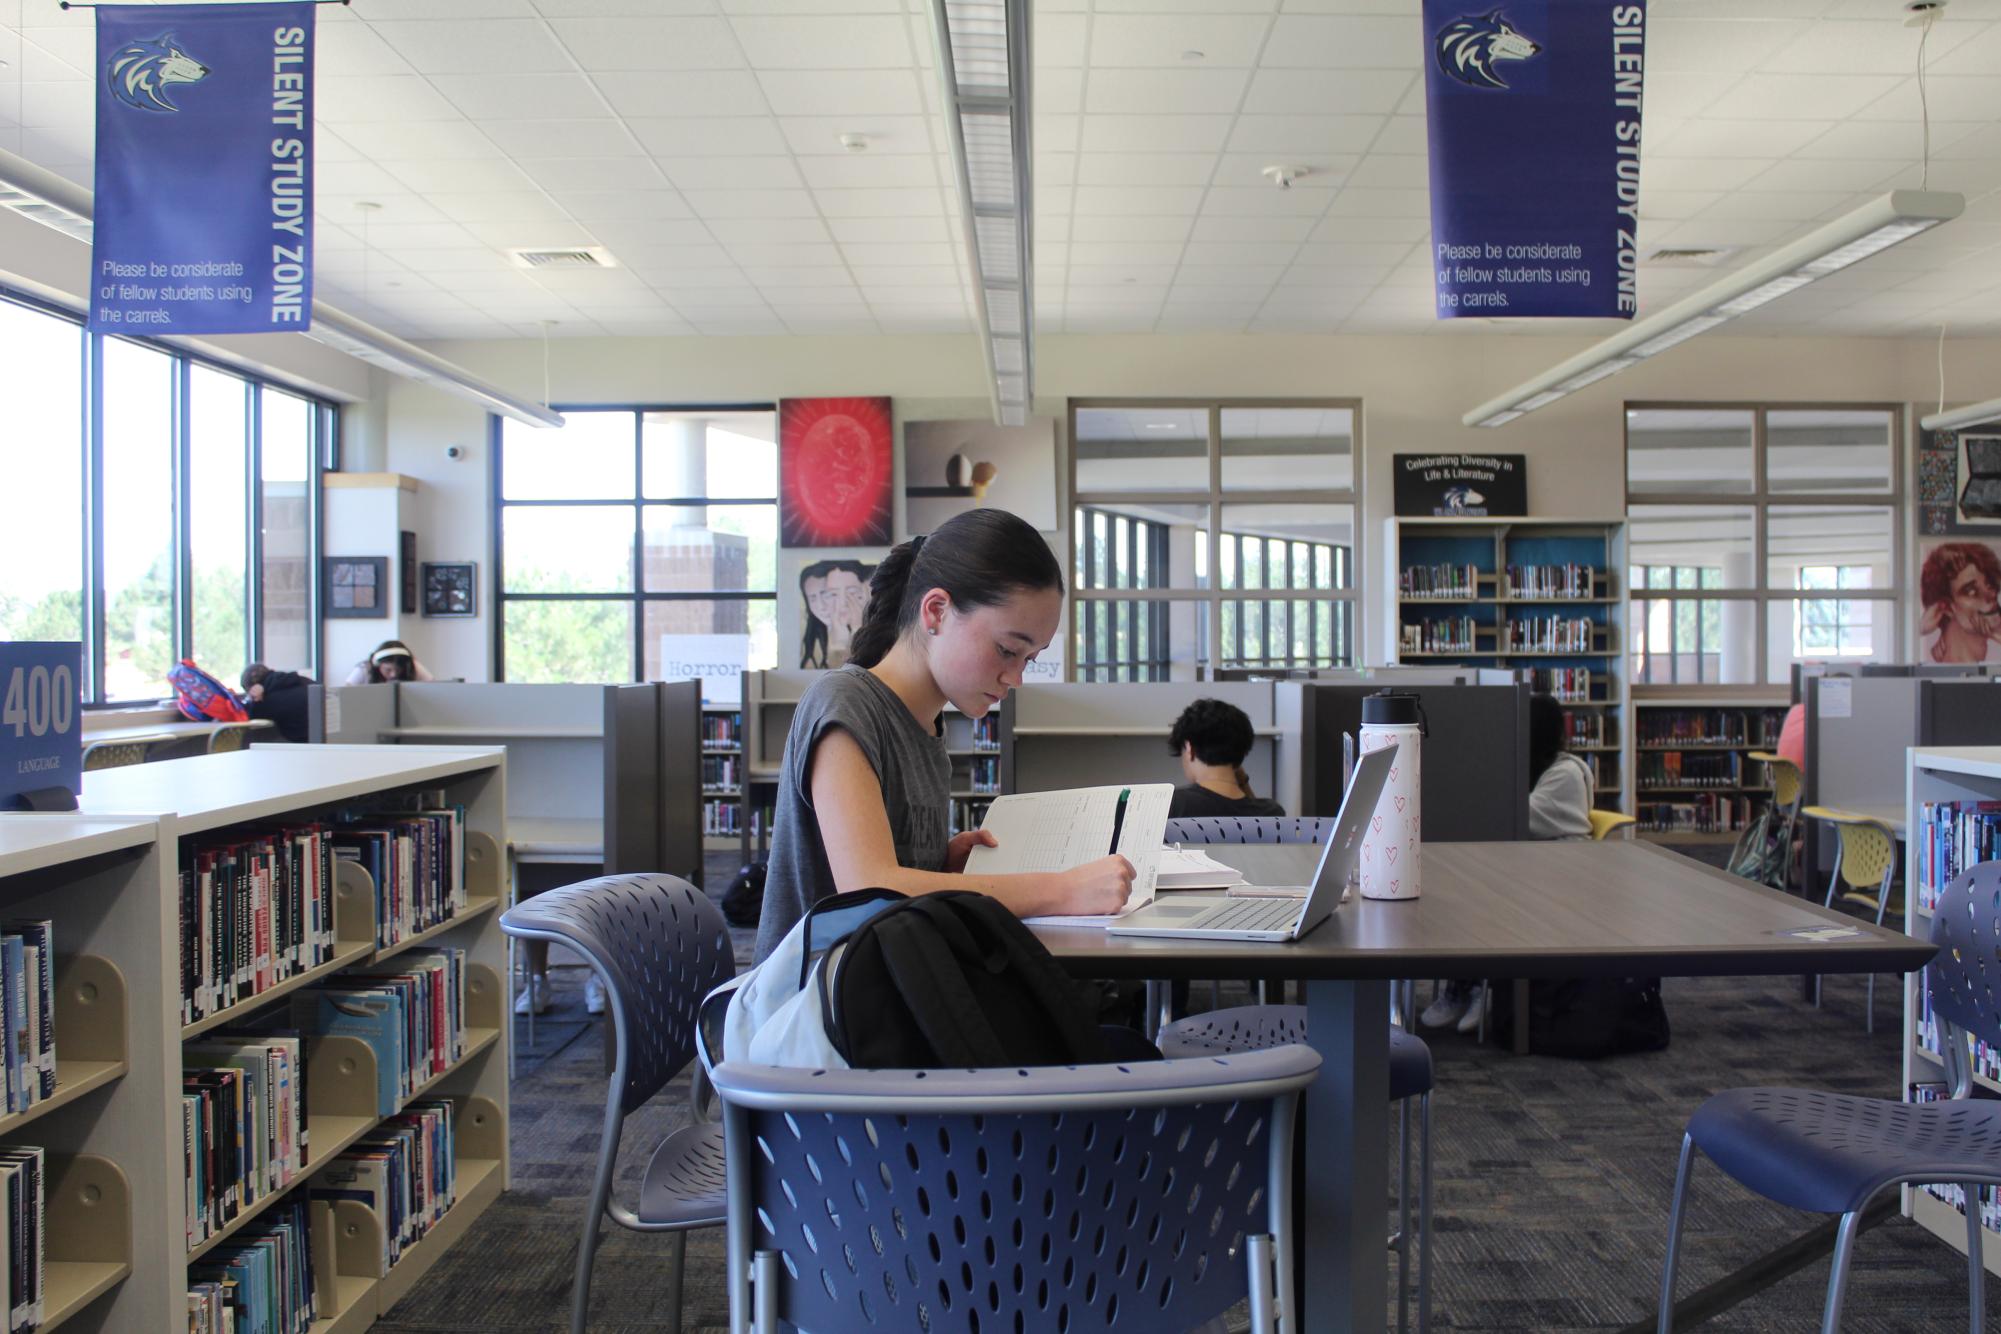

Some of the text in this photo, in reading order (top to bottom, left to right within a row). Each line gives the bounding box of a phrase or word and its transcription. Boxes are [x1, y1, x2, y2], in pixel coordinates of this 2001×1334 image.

[1612, 5, 1643, 313] SILENT STUDY ZONE
[271, 26, 305, 323] SILENT STUDY ZONE
[1438, 243, 1582, 259] Please be considerate
[103, 261, 243, 277] Please be considerate
[1439, 267, 1591, 286] of fellow students using
[101, 284, 253, 303] of fellow students using
[1440, 291, 1510, 307] the carrels.
[100, 307, 172, 324] the carrels.
[1406, 455, 1513, 471] Celebrating Diversity in
[1424, 469, 1496, 482] Life & Literature
[669, 661, 742, 676] Horror
[3, 664, 74, 738] 400
[18, 756, 61, 774] LANGUAGE
[16, 972, 25, 1018] KANGAROOS
